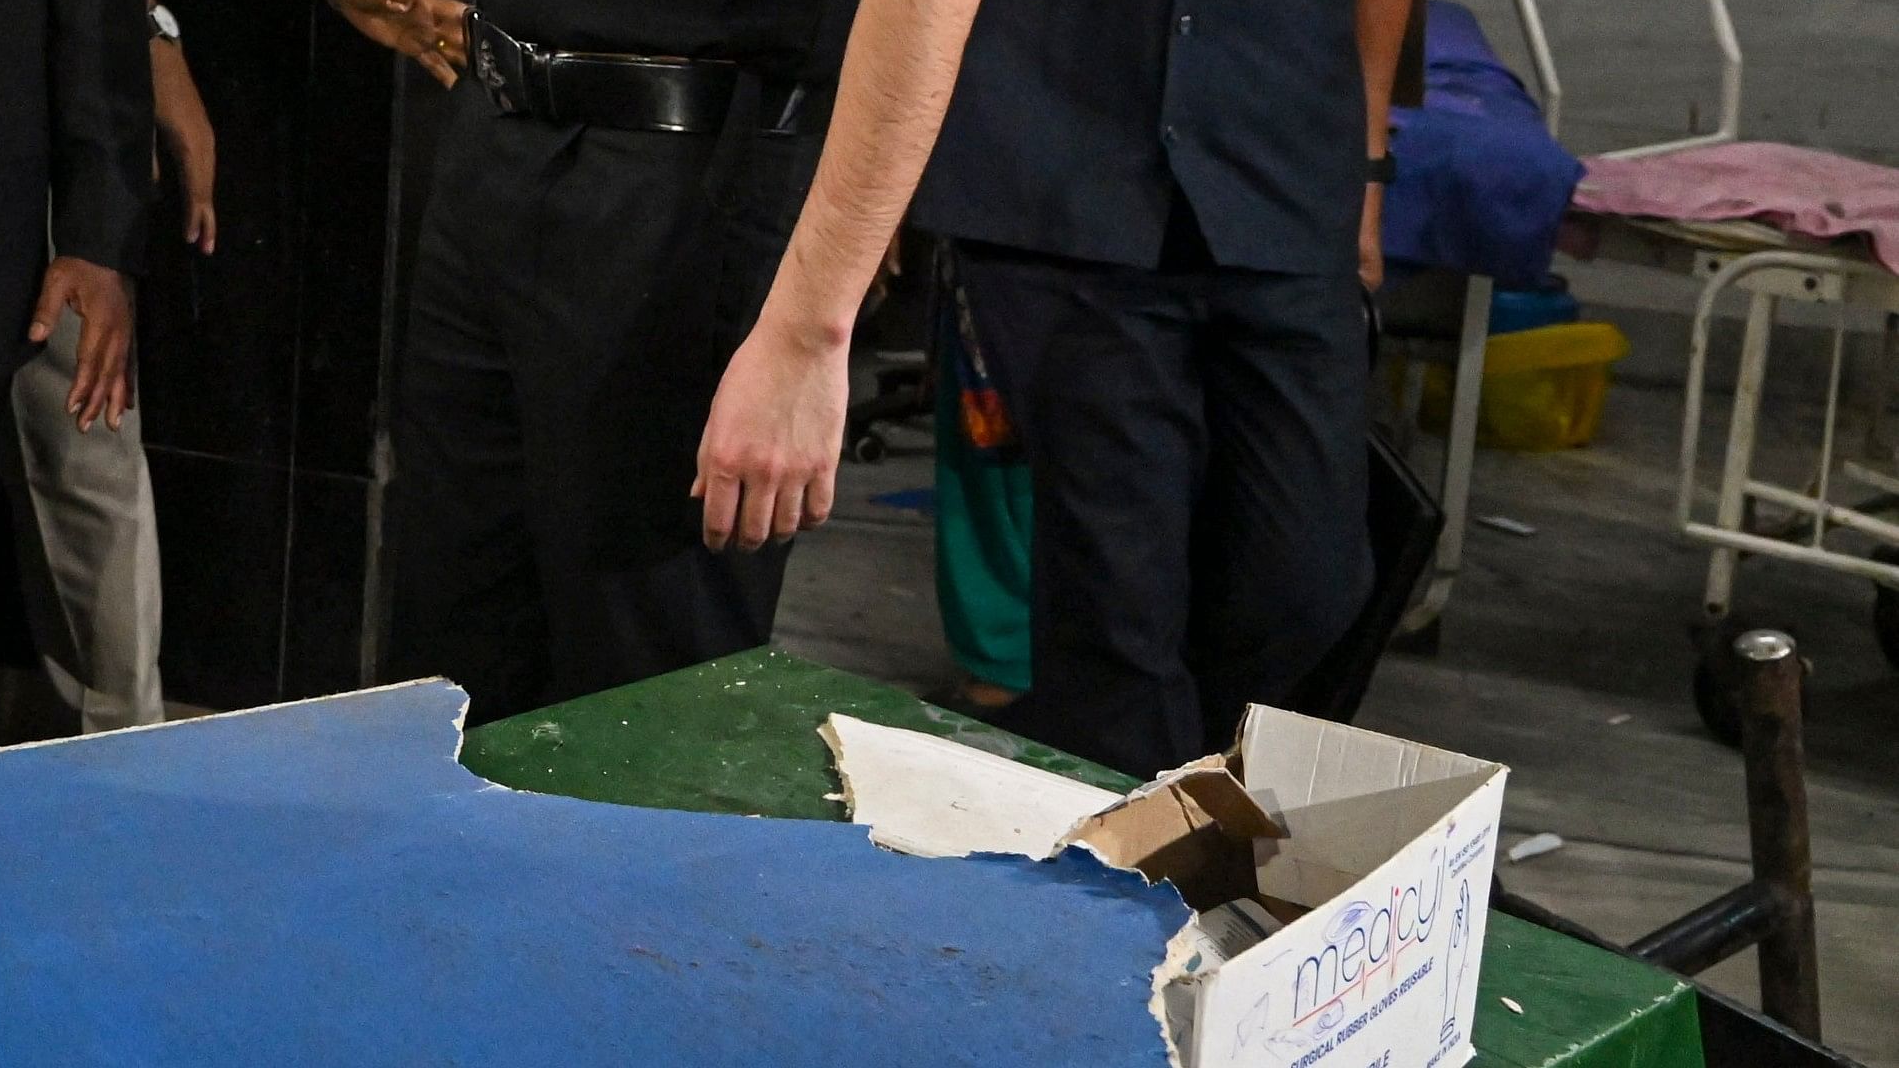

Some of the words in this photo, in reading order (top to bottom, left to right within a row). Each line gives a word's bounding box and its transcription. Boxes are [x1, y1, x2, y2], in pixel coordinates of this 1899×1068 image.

[1336, 1011, 1369, 1047] RUBBER
[1369, 986, 1399, 1022] GLOVES
[1398, 955, 1435, 999] REUSABLE
